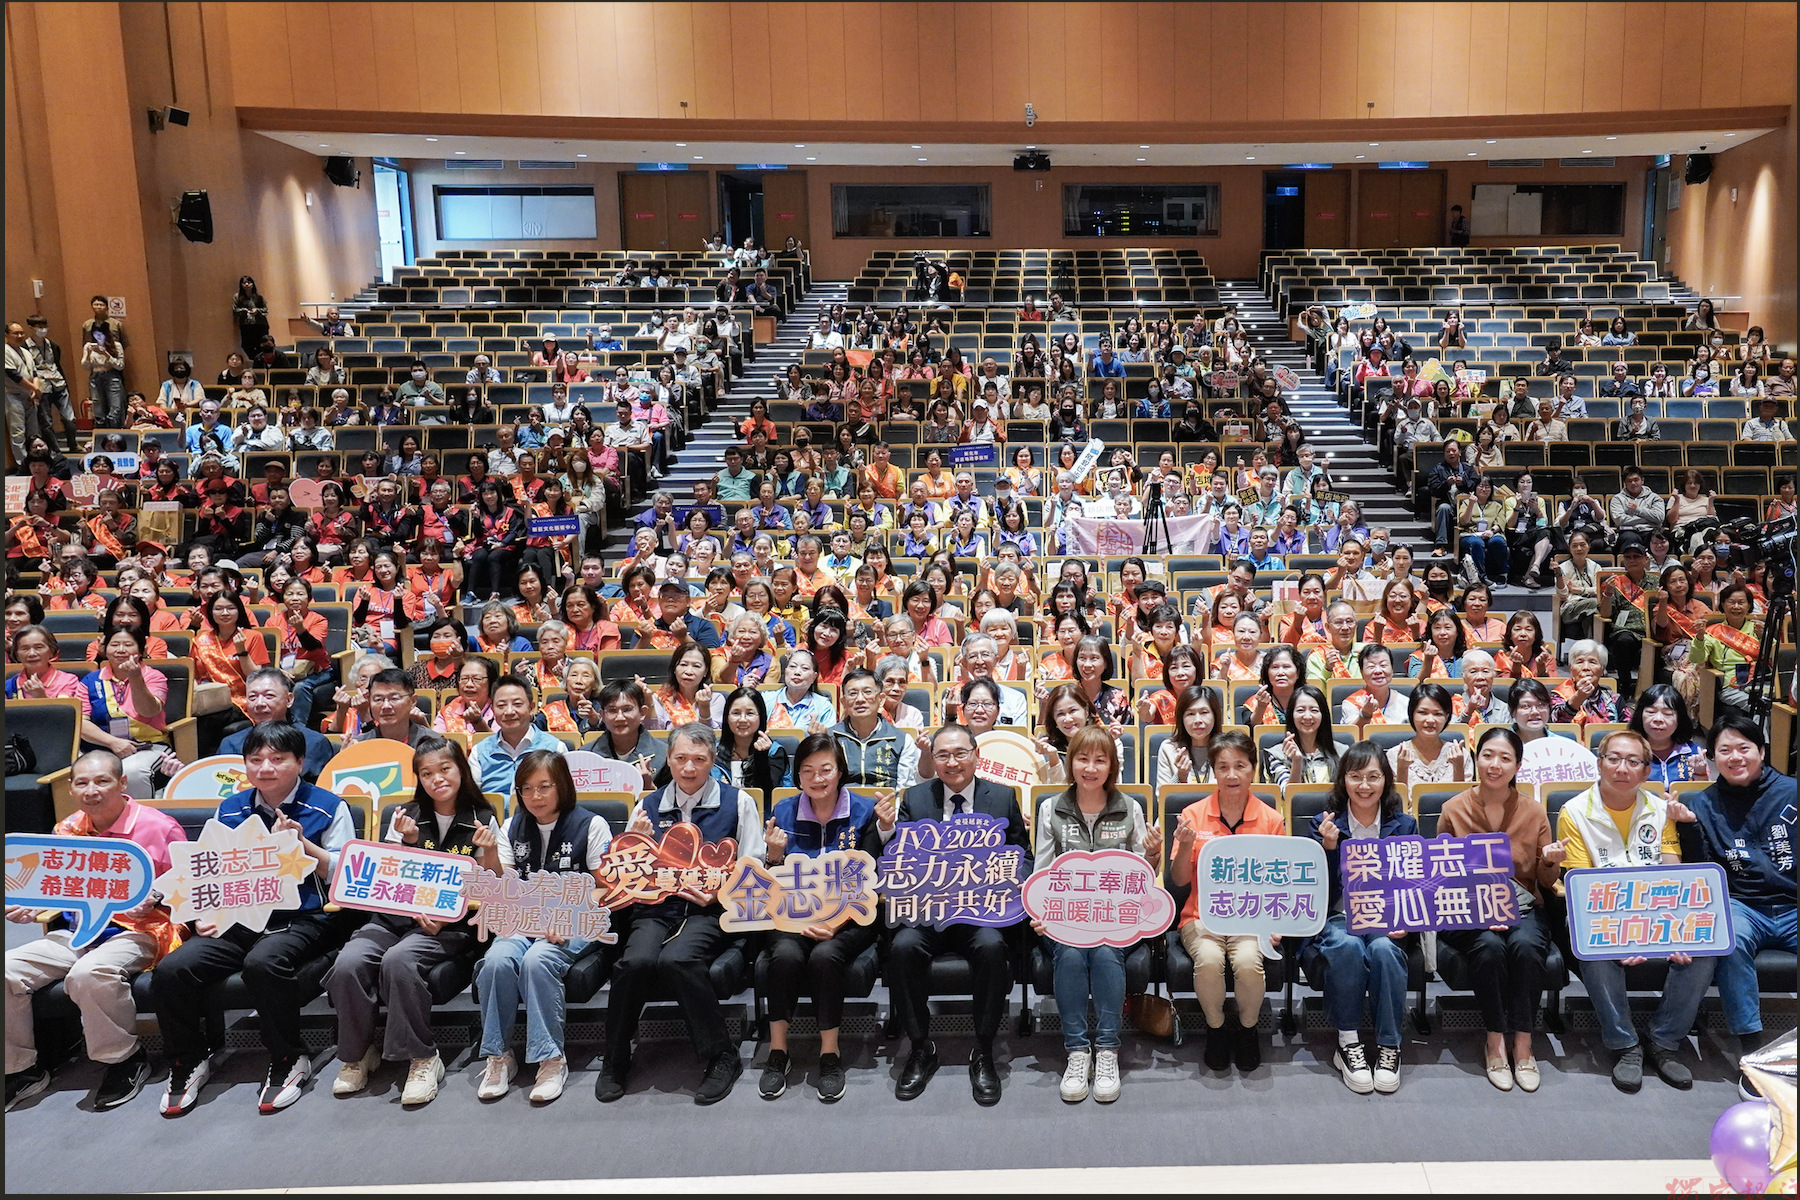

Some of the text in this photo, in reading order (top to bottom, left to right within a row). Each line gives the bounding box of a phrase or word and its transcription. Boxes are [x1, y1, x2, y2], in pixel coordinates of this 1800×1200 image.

[571, 768, 609, 787] 志工
[976, 757, 1033, 785] 我是志工
[1067, 823, 1081, 850] 石一
[1770, 823, 1794, 872] 劉美芳
[41, 848, 132, 874] 志力傳承
[190, 845, 280, 877] 我志工
[377, 855, 462, 886] 志在新北
[873, 850, 1020, 893] 志力永續
[1210, 856, 1316, 884] 新北志工
[1346, 838, 1509, 882] 榮耀志工
[40, 875, 130, 900] 希望傳遞
[191, 876, 282, 910] 我驕傲
[371, 880, 460, 911] 永續發展
[460, 868, 596, 910] 志心奉獻
[728, 858, 870, 923] 金志獎
[1048, 869, 1146, 894] 志工奉獻
[1587, 877, 1711, 911] 新北齊心
[889, 888, 1014, 924] 同行共好
[1042, 899, 1140, 924] 溫暖社會
[1208, 889, 1317, 919] 志力不凡
[1349, 883, 1516, 930] 愛心無限
[472, 902, 615, 941] 傳遞溫暖
[1588, 912, 1715, 945] 志向永續
